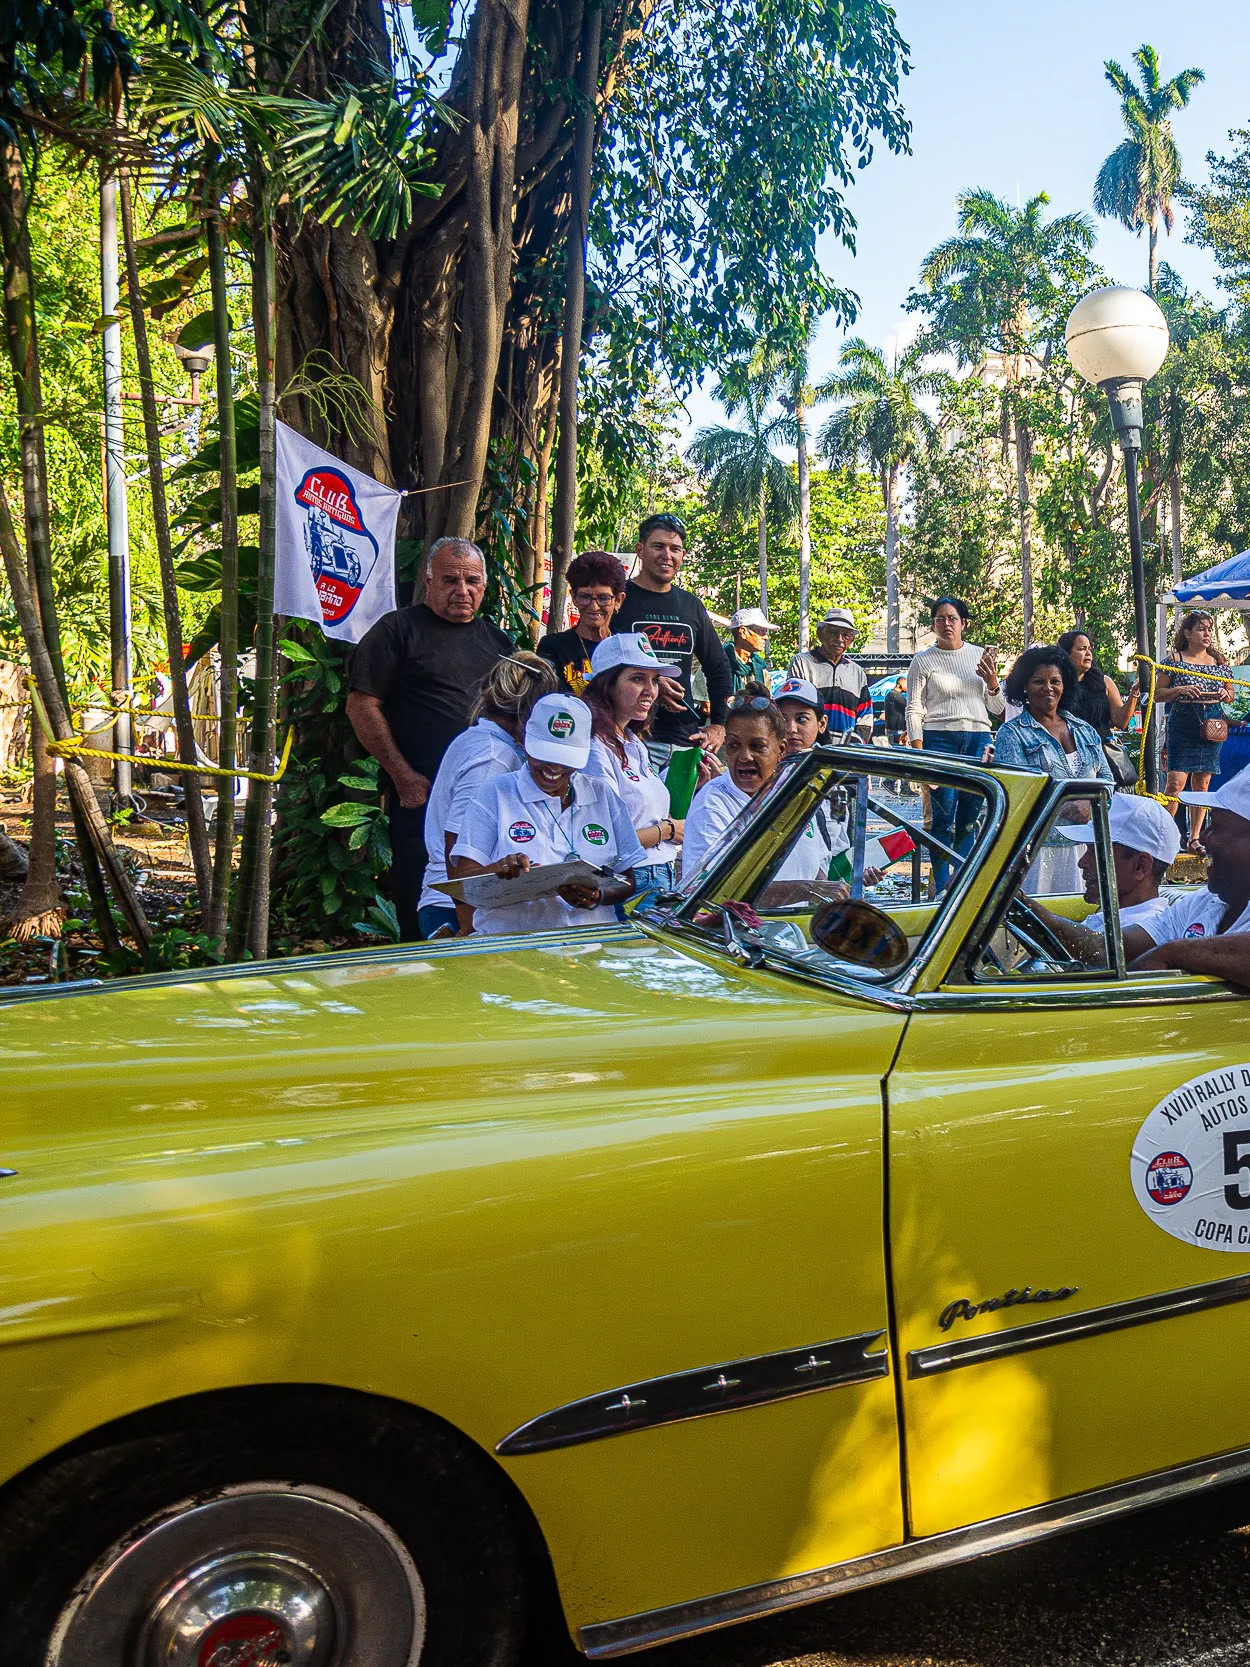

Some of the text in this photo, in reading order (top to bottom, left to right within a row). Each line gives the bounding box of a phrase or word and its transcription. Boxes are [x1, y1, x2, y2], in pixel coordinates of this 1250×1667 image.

[1196, 1071, 1238, 1104] RALLY
[1200, 1095, 1248, 1132] AUTOS
[1195, 1218, 1233, 1244] COPA
[938, 1283, 1079, 1332] Pontiac
